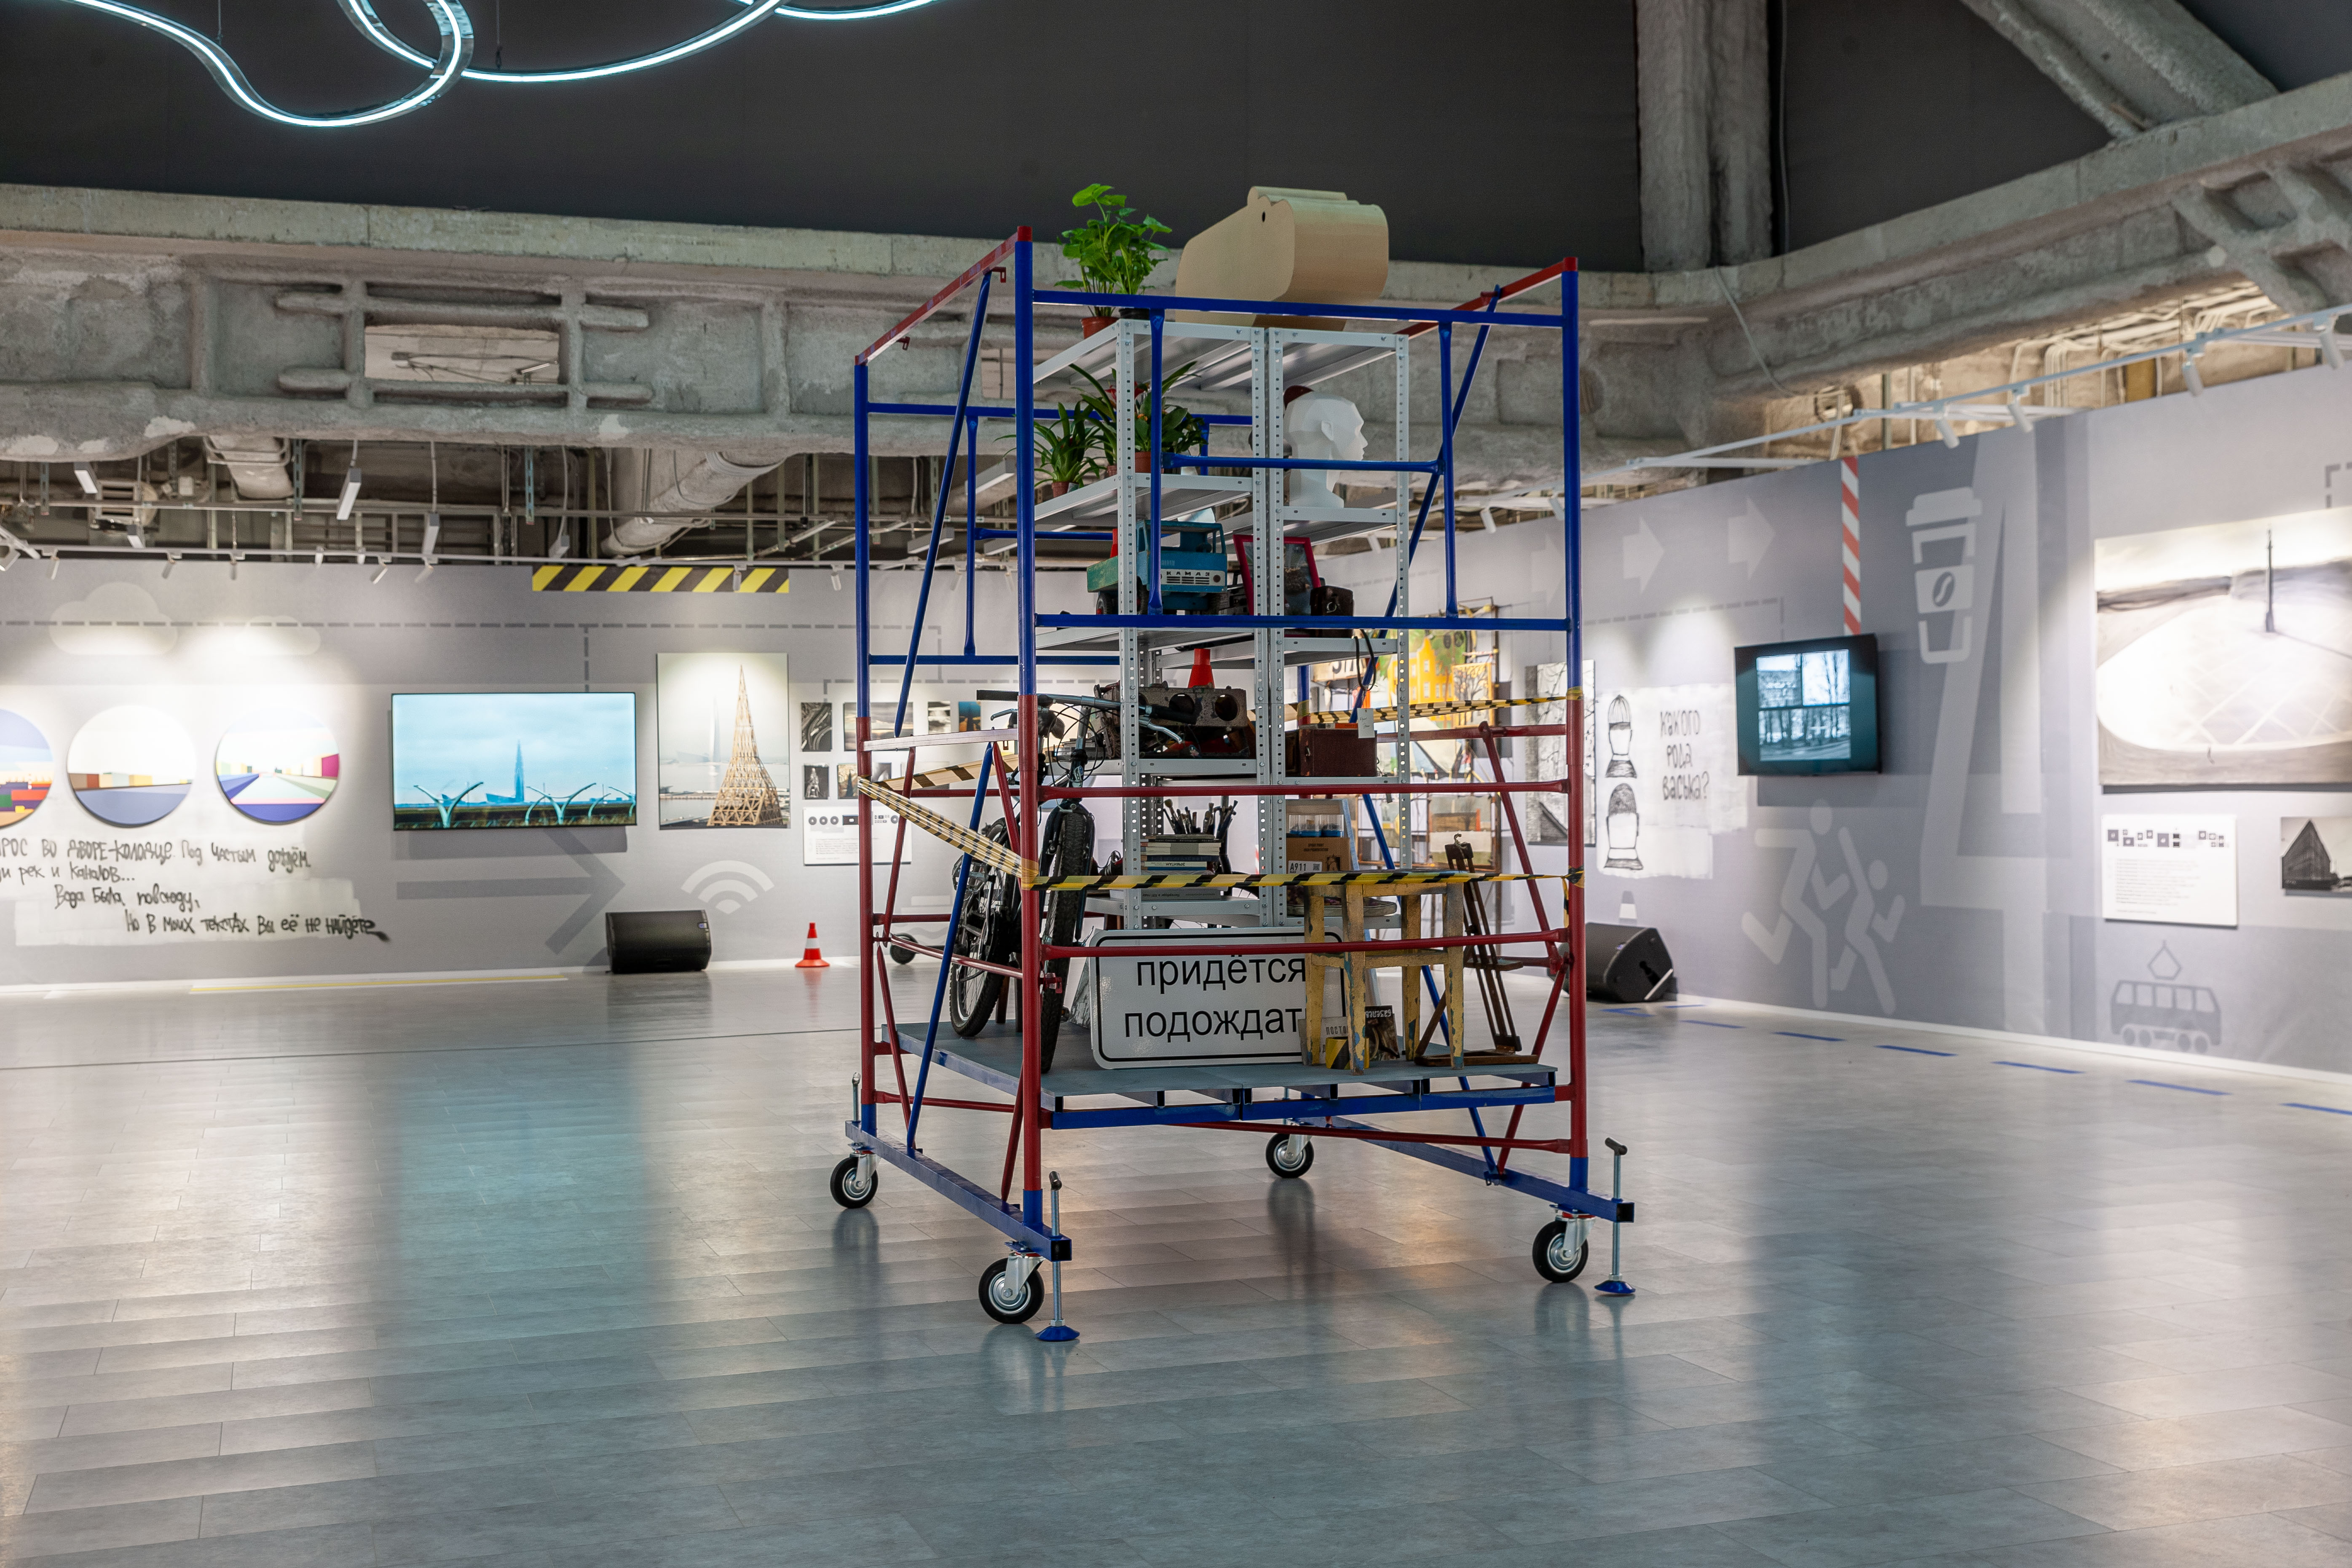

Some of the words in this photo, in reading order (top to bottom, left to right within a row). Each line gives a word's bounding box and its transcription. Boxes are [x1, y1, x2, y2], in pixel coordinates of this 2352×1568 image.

[0, 838, 28, 857] РОС
[18, 866, 45, 885] рек
[51, 866, 60, 877] и
[1290, 863, 1306, 871] A911
[54, 884, 85, 909] Вода
[124, 909, 140, 932] Но
[281, 914, 300, 932] её
[1137, 954, 1306, 994] придётся
[1125, 1008, 1307, 1043] подождат
[1326, 1026, 1348, 1035] ПОСТО
